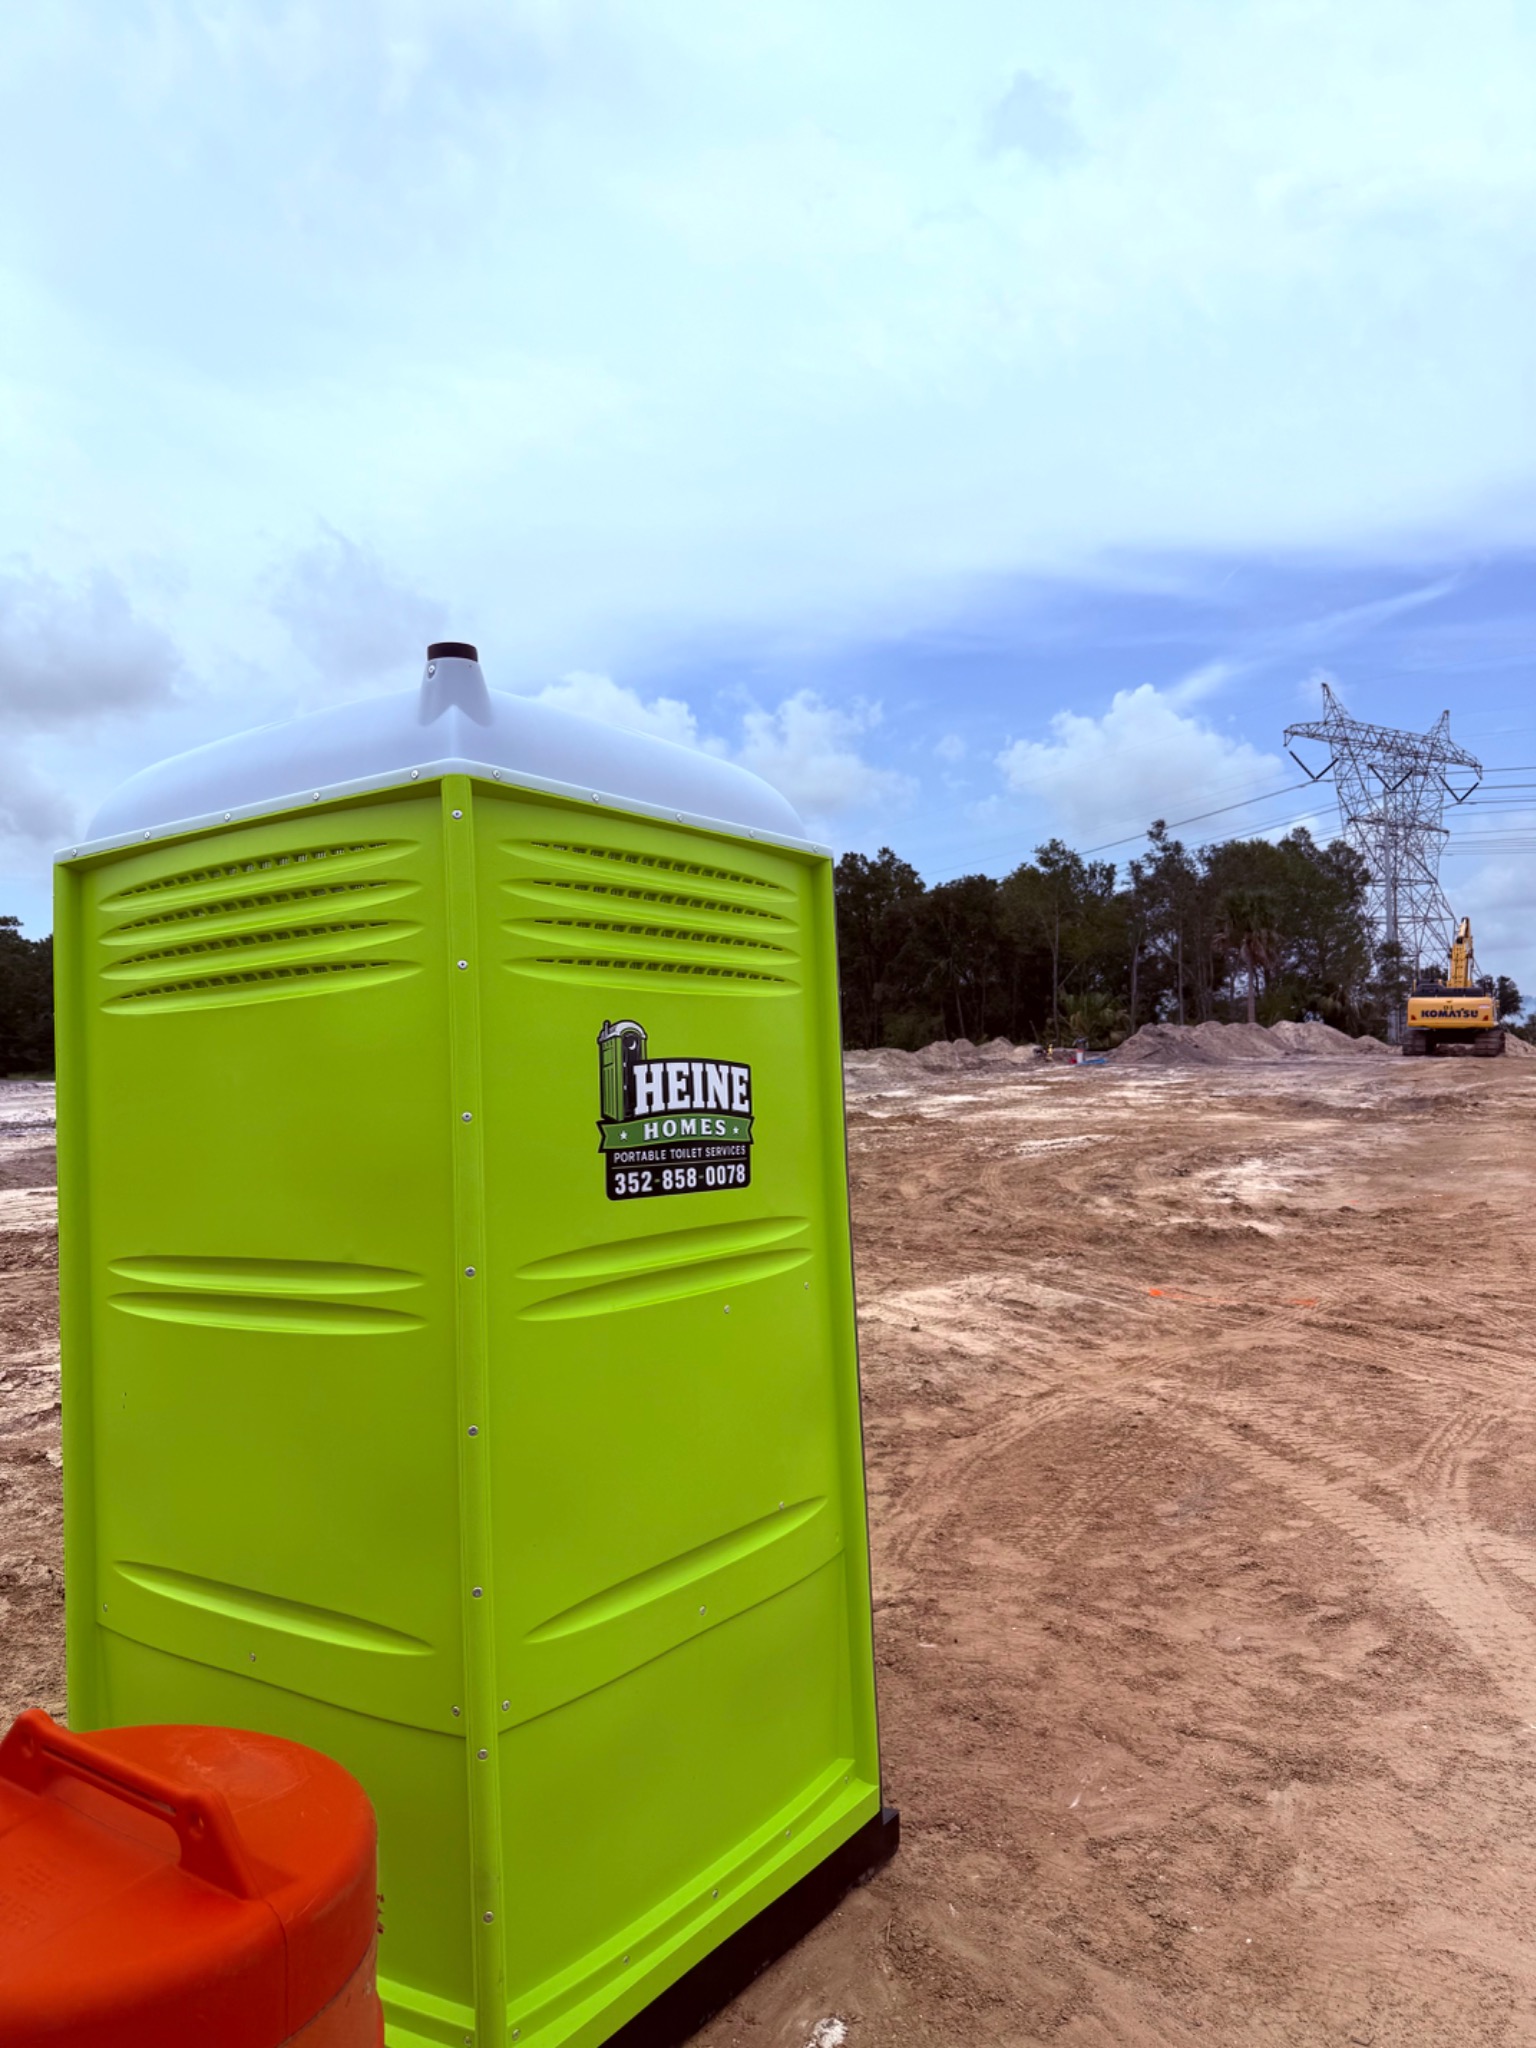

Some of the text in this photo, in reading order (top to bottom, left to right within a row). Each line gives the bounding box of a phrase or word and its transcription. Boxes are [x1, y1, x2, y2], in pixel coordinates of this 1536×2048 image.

[1421, 1008, 1479, 1018] KOMATSU
[633, 1062, 750, 1115] HEINE
[643, 1118, 727, 1140] HOMES
[613, 1145, 746, 1163] PORTABLE TOILET SERVICES
[614, 1163, 746, 1195] 352-858-0078
